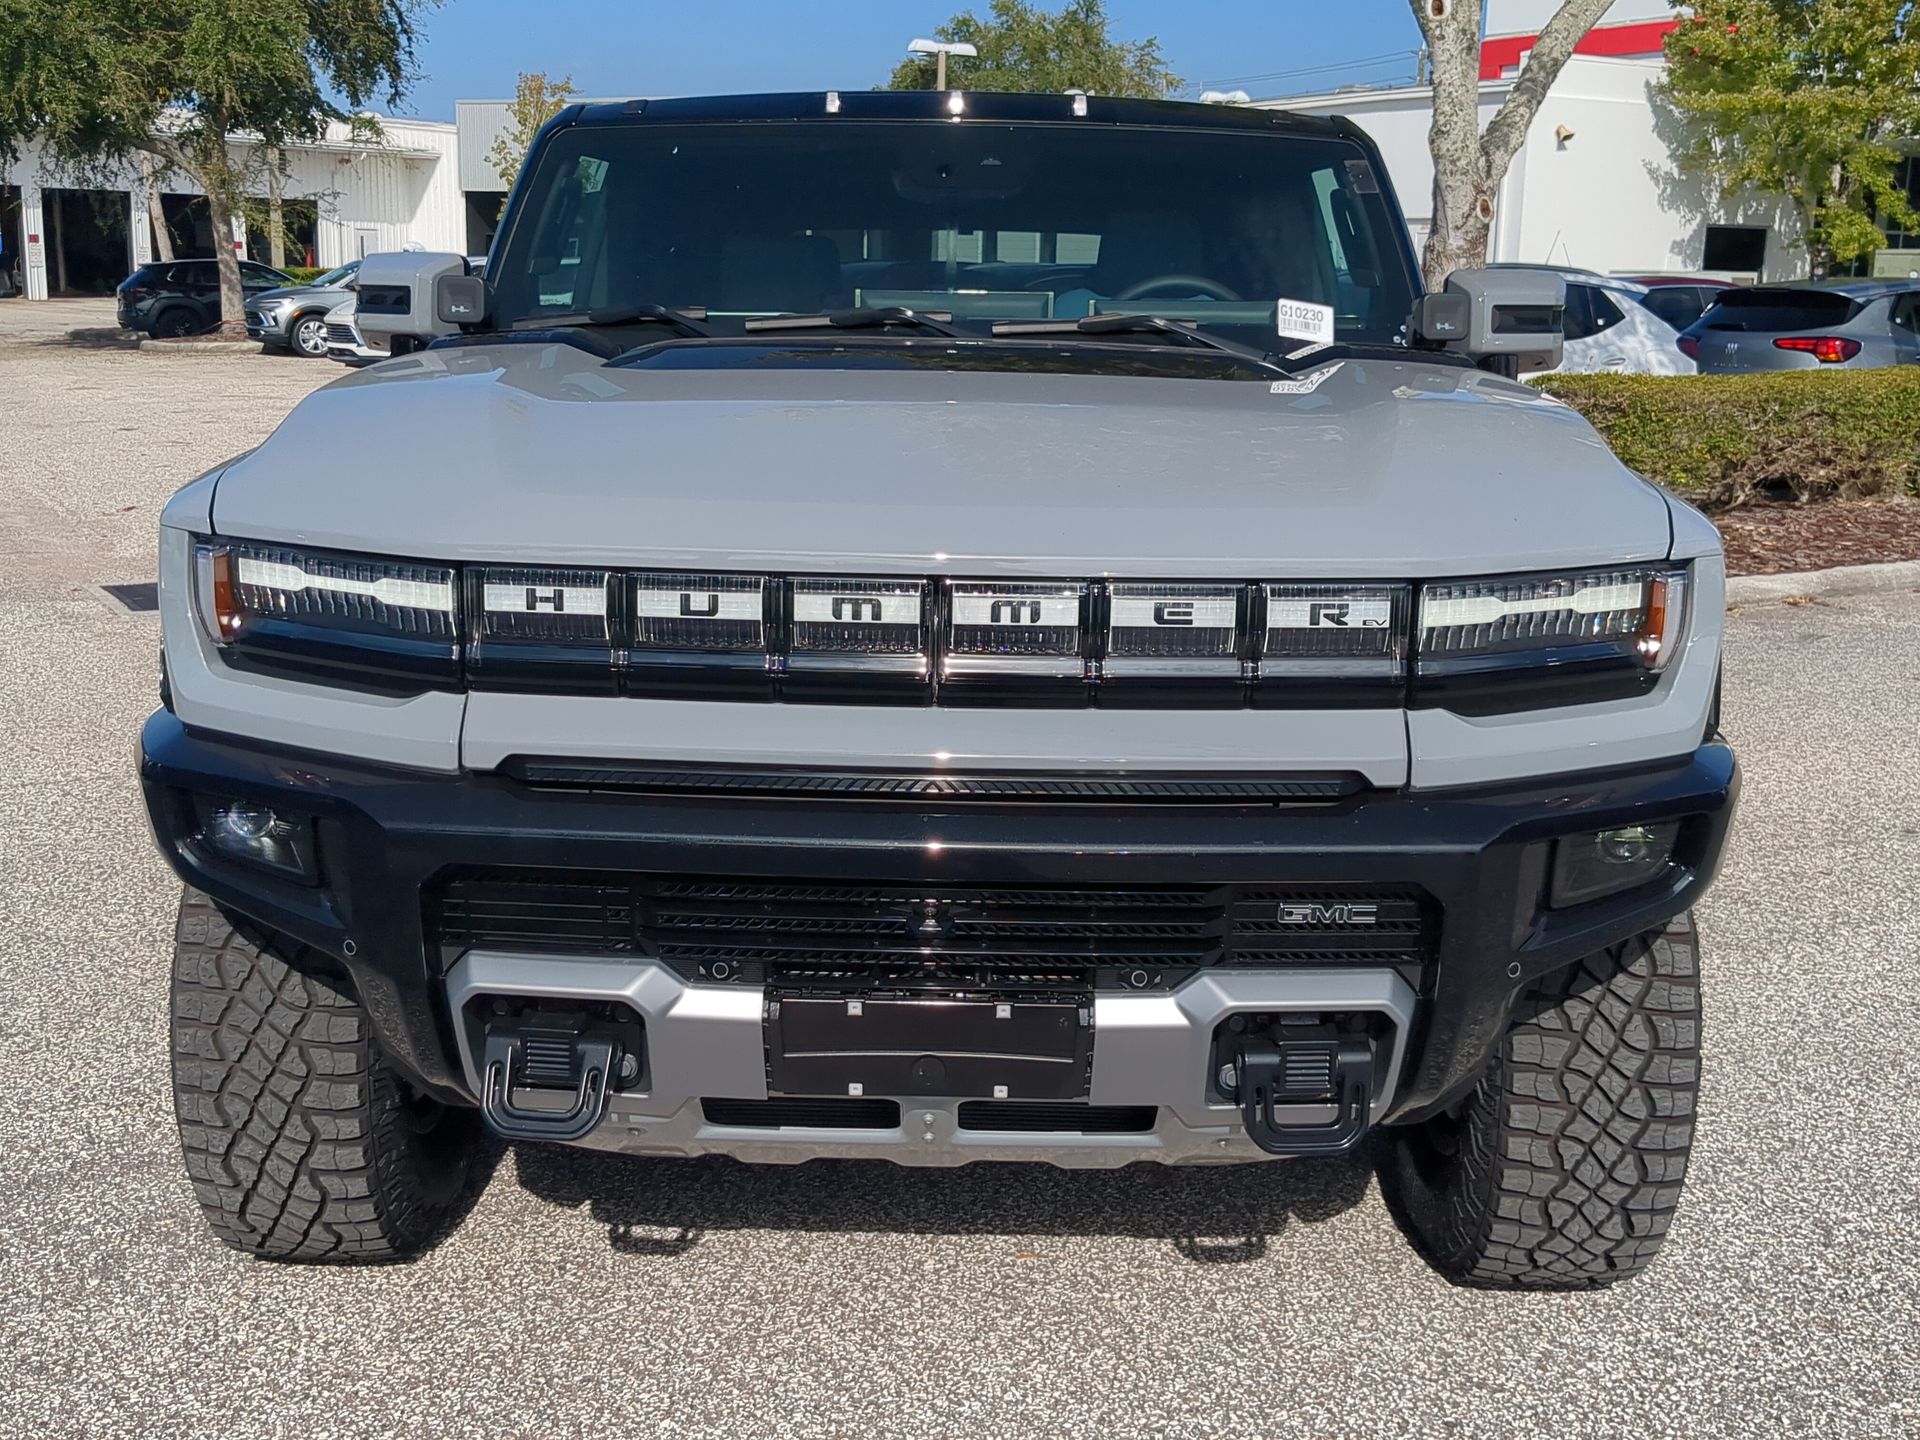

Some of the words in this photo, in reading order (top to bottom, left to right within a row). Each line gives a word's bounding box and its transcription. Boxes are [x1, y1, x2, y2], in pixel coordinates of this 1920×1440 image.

[1280, 304, 1324, 322] G10230
[526, 588, 1350, 627] HUMMER
[1277, 902, 1378, 923] GMC
